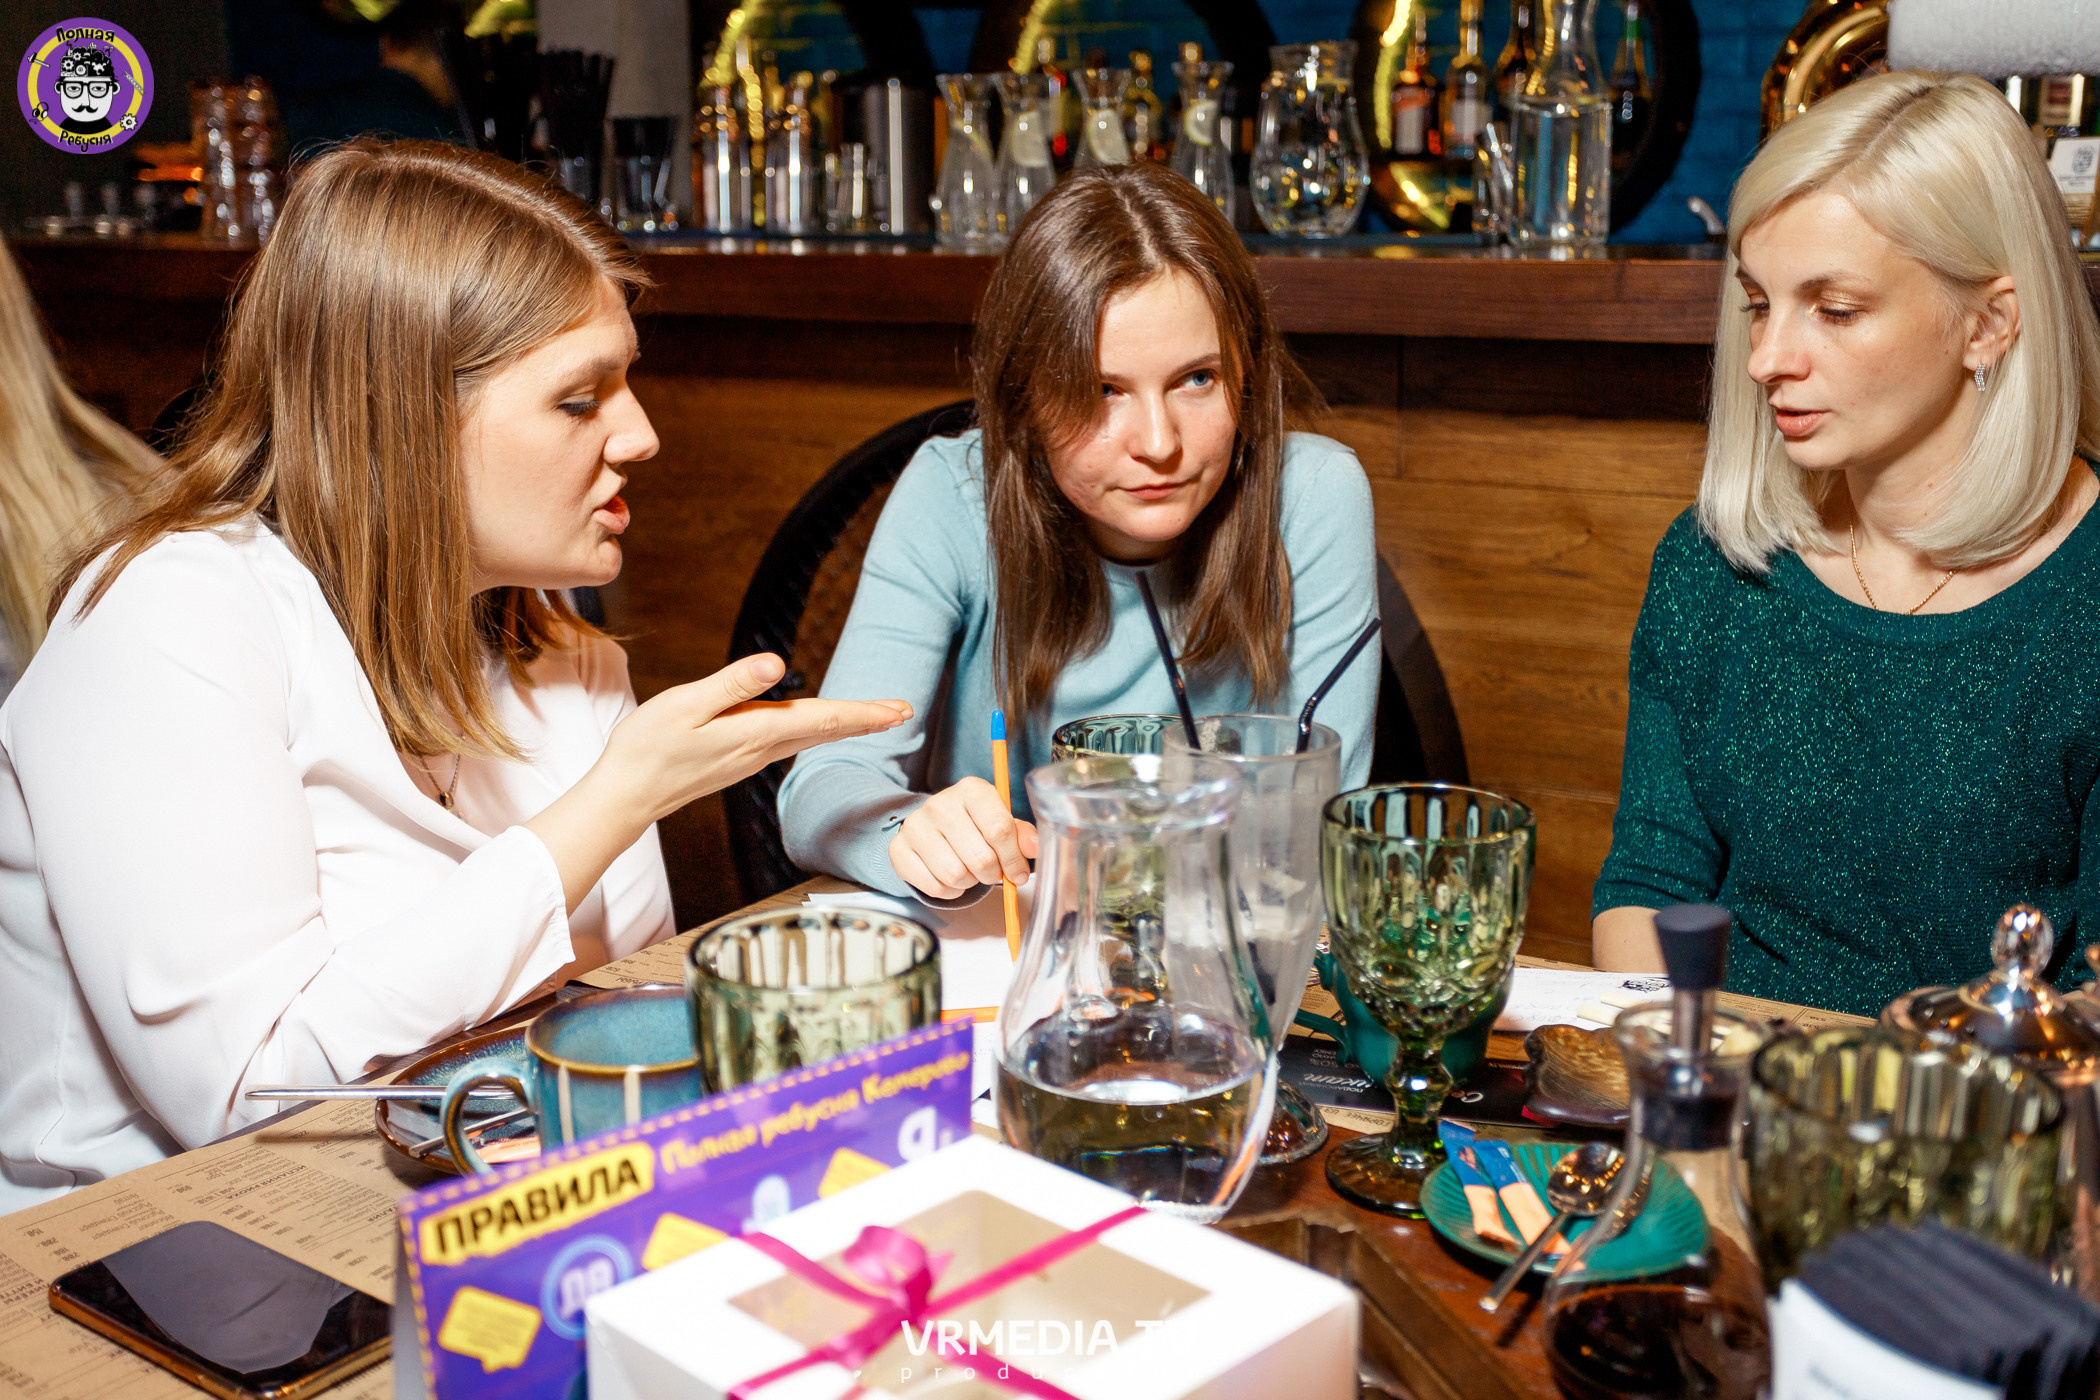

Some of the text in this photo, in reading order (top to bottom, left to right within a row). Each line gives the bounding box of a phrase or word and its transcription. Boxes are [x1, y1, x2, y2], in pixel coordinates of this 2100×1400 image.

[1345, 1112, 1391, 1127] ГОРЯЧЕЕ
[260, 1164, 307, 1186] ИСПАНИЯ
[437, 1158, 640, 1256] ПРАВИЛА
